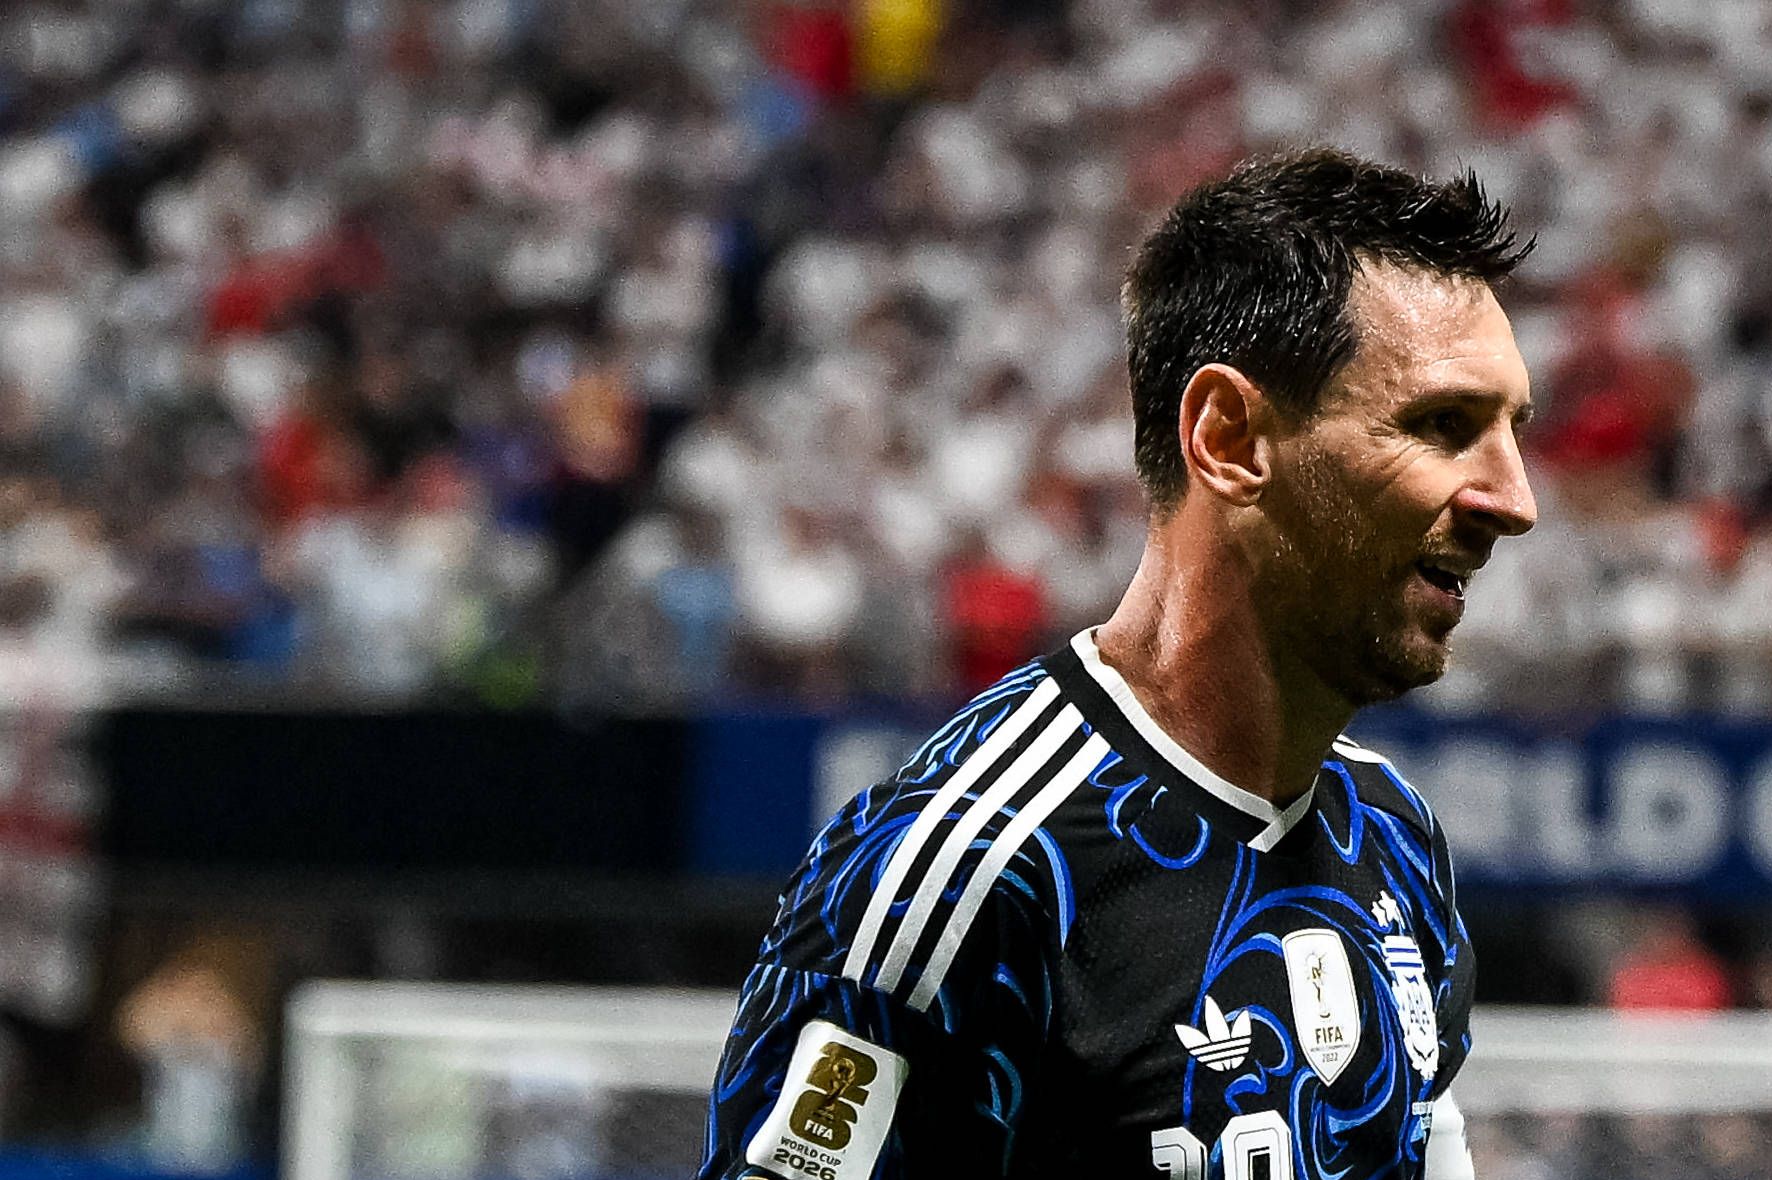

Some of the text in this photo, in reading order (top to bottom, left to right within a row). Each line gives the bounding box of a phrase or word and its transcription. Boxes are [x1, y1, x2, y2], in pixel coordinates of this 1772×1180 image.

[1315, 1026, 1343, 1044] FIFA
[804, 1119, 834, 1141] FIFA
[780, 1136, 842, 1167] WORLD CUP
